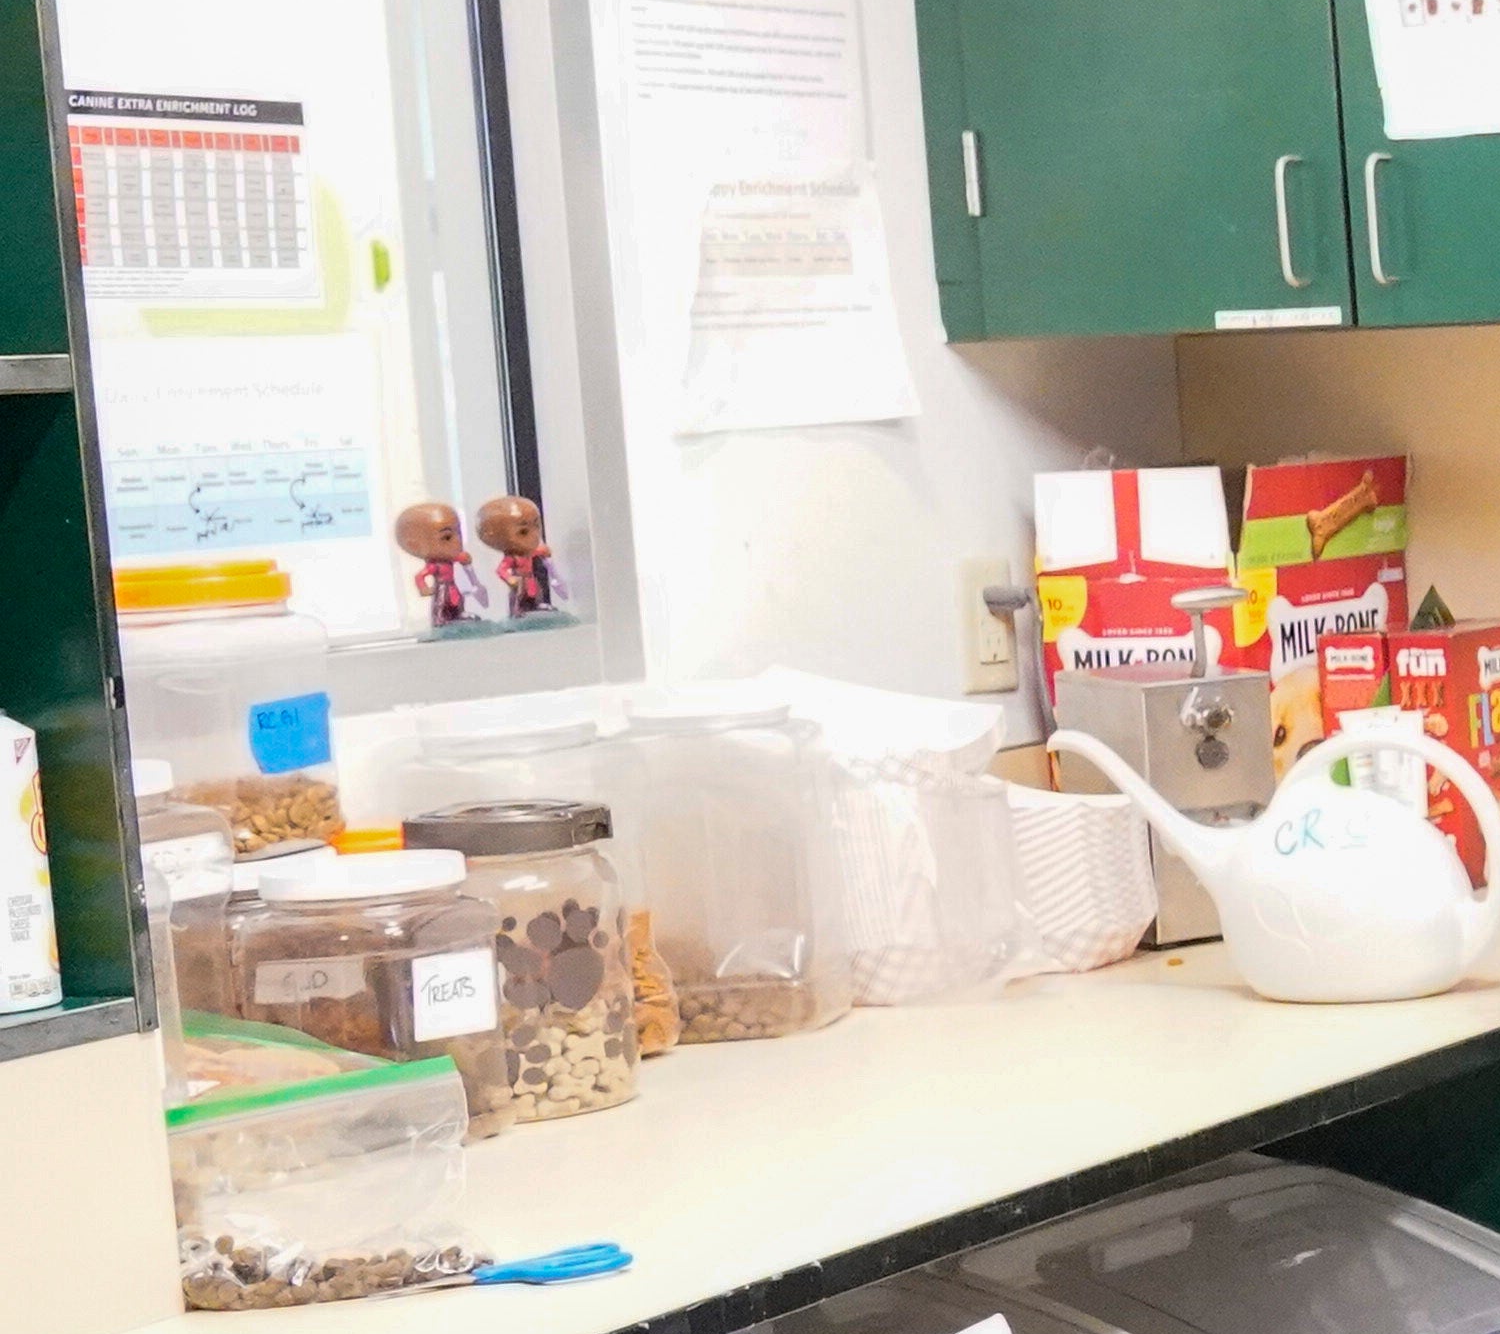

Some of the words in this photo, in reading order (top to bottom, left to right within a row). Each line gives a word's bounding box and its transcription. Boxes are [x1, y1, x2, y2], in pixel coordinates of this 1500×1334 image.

[68, 94, 115, 109] CANINE
[117, 96, 153, 112] EXTRA
[156, 98, 231, 115] ENRICHMENT
[233, 104, 258, 117] LOG
[1073, 649, 1195, 670] MILK-BON
